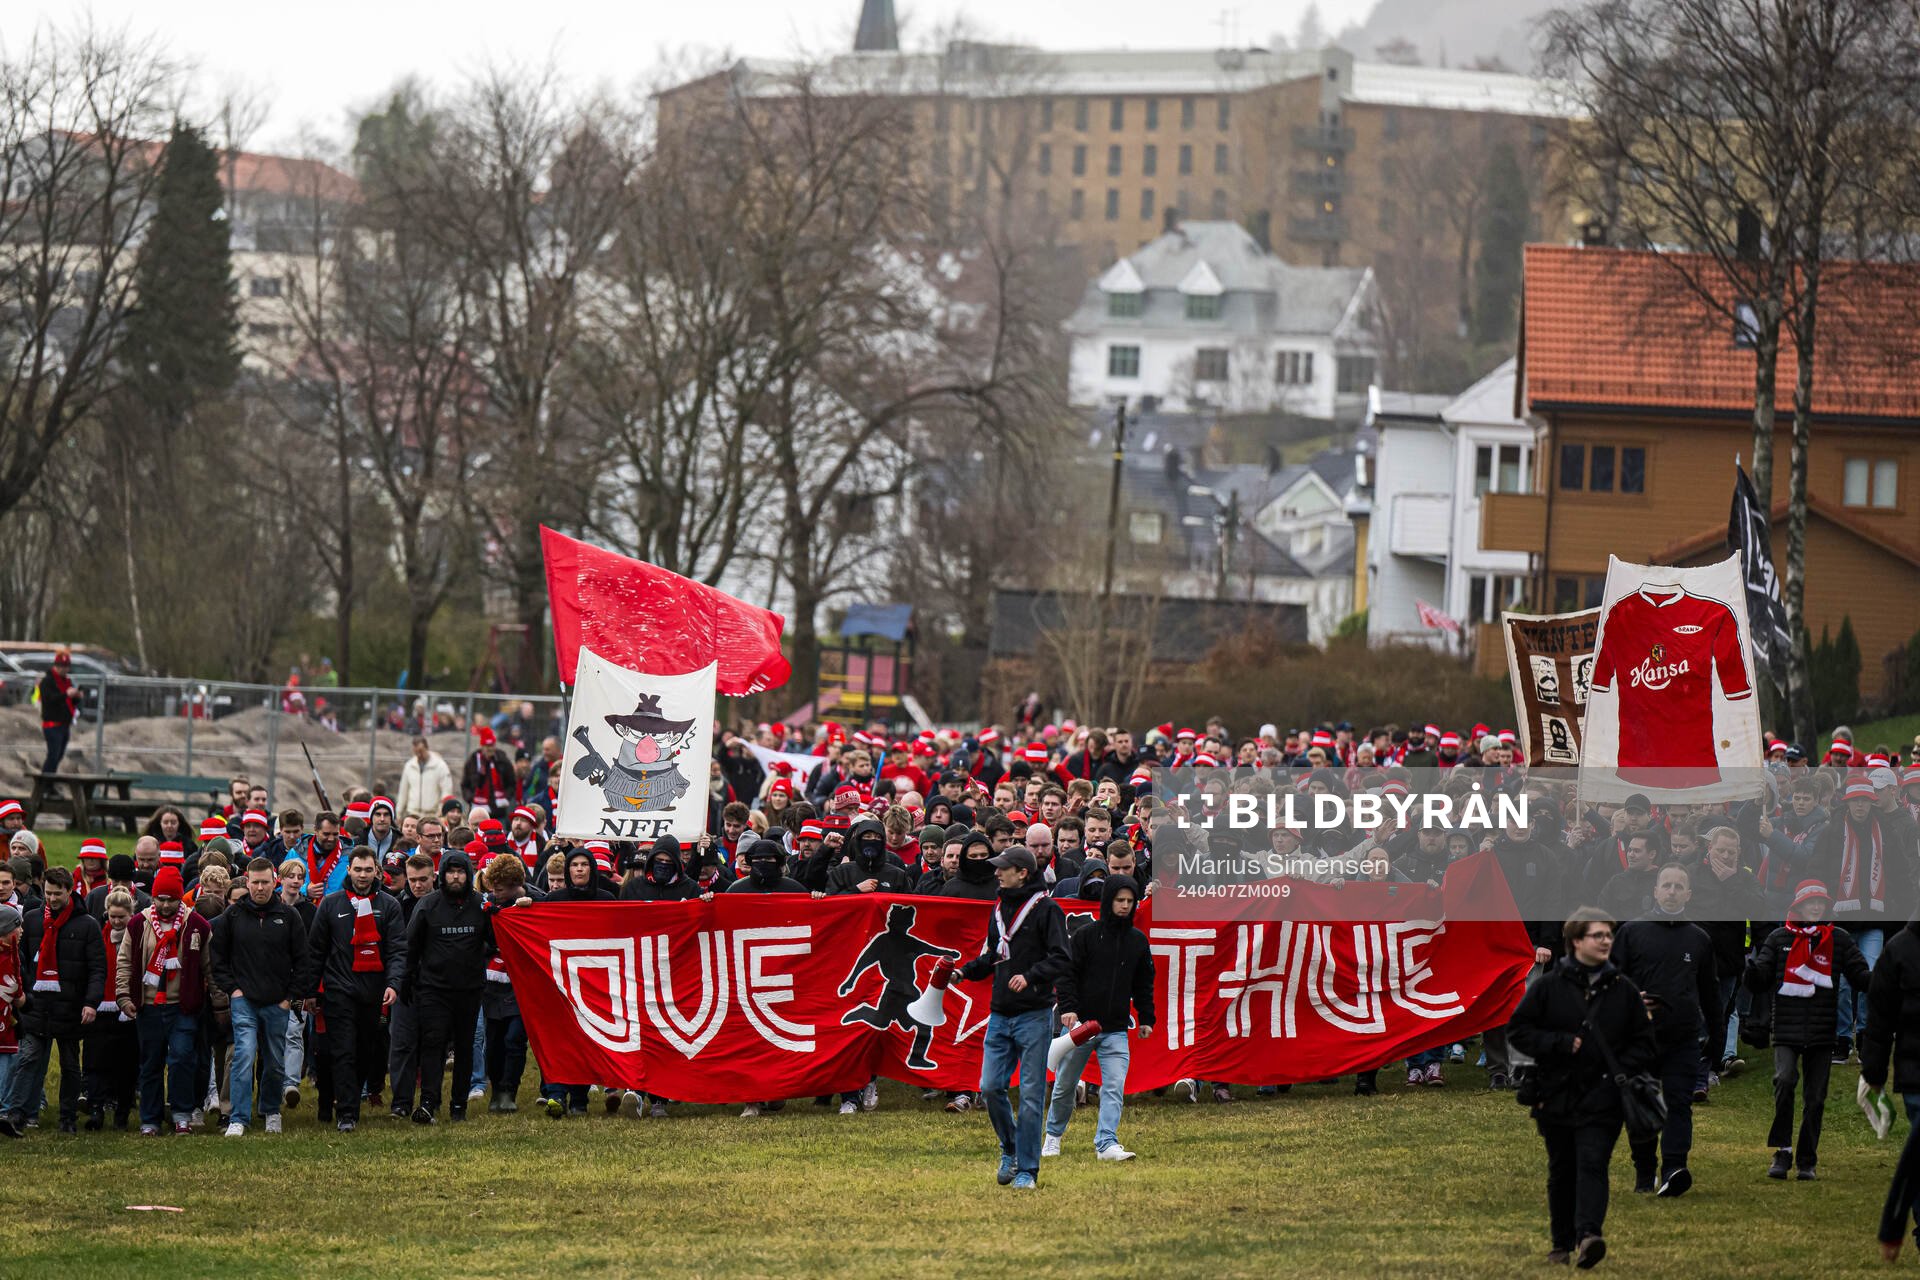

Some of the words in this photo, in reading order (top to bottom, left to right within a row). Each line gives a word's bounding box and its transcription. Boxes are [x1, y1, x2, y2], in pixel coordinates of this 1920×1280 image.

[1523, 622, 1600, 654] WANTE
[1630, 656, 1691, 691] Hansa
[596, 817, 674, 839] NFF
[441, 926, 475, 935] BERGEN
[549, 925, 816, 1060] OVE
[1149, 913, 1466, 1051] THUE
